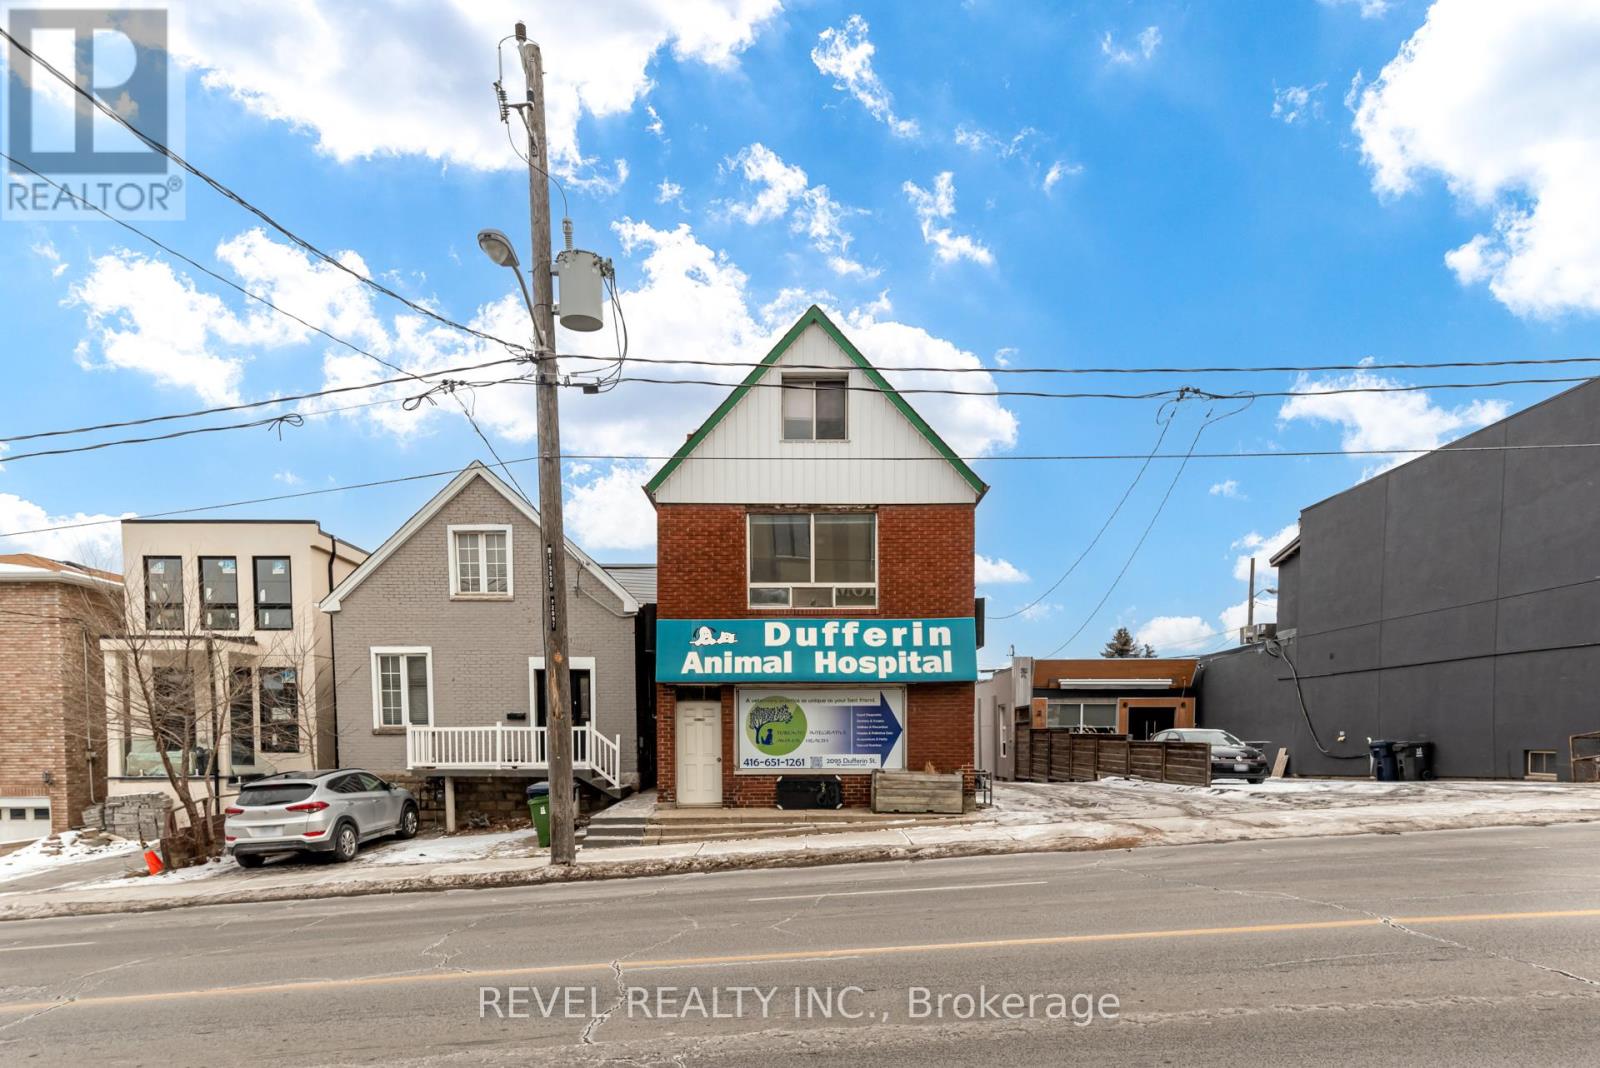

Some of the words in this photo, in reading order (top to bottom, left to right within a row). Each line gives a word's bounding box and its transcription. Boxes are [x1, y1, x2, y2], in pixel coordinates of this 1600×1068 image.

[764, 621, 951, 647] Dufferin
[681, 650, 793, 674] Animal
[815, 650, 953, 679] Hospital
[743, 758, 805, 767] 416-651-1261
